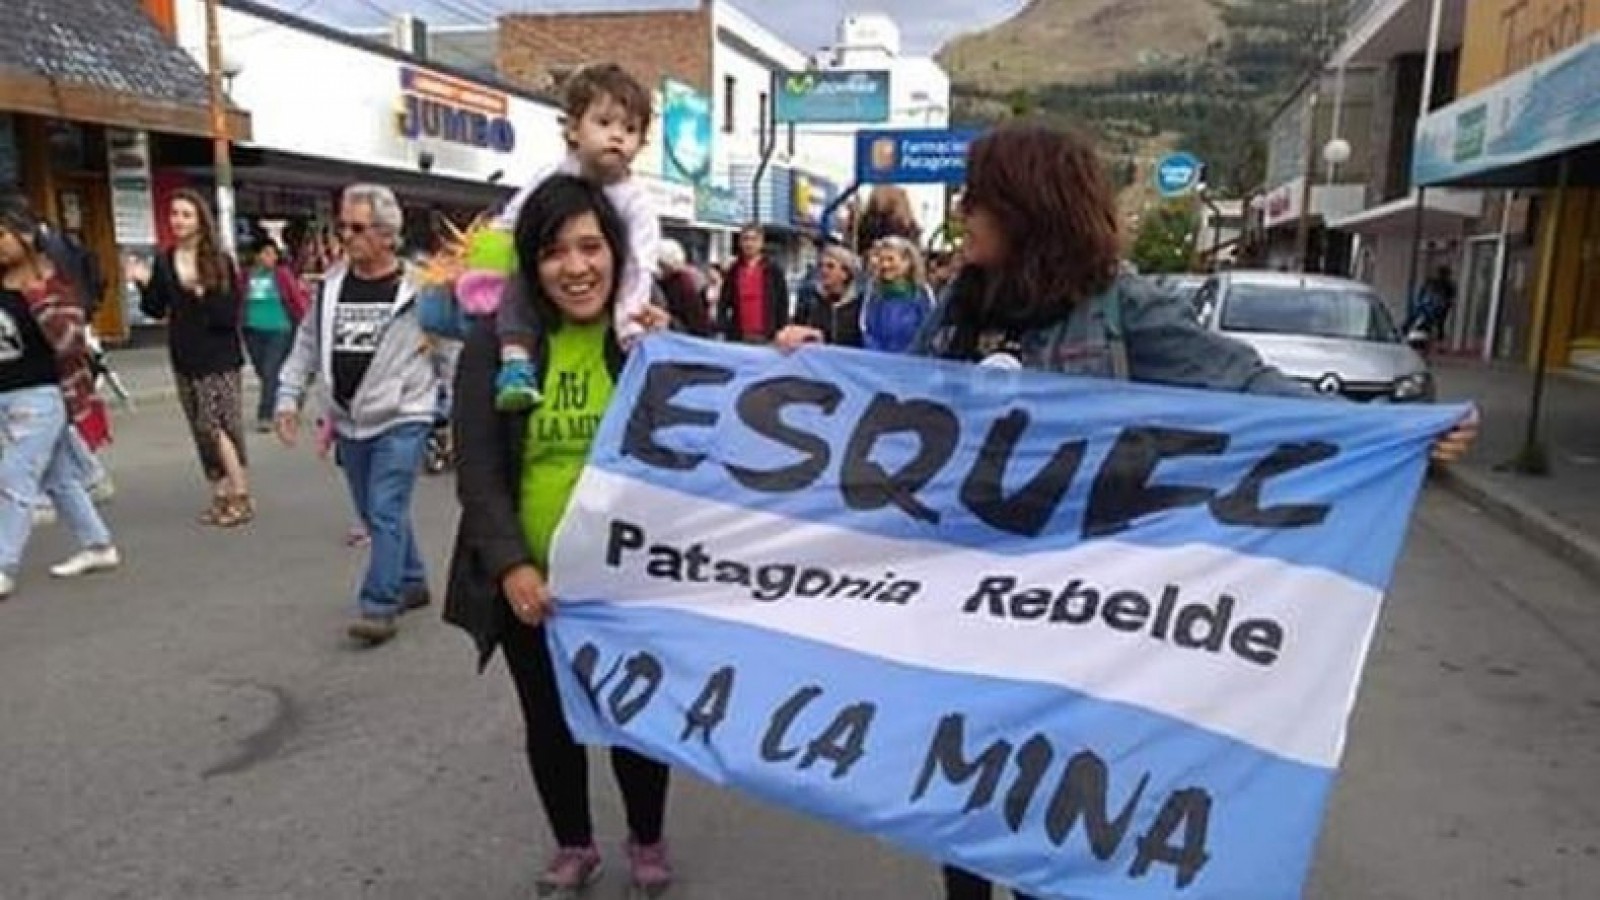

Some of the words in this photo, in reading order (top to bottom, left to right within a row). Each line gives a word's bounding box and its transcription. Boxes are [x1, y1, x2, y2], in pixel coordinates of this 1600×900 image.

[397, 94, 515, 153] JUMBO
[567, 414, 603, 440] MIN
[605, 518, 922, 606] Patagonia
[962, 575, 1284, 666] Rebelde
[571, 642, 664, 726] NO
[679, 665, 736, 746] A
[760, 684, 877, 780] LA
[908, 711, 1213, 889] MINA
